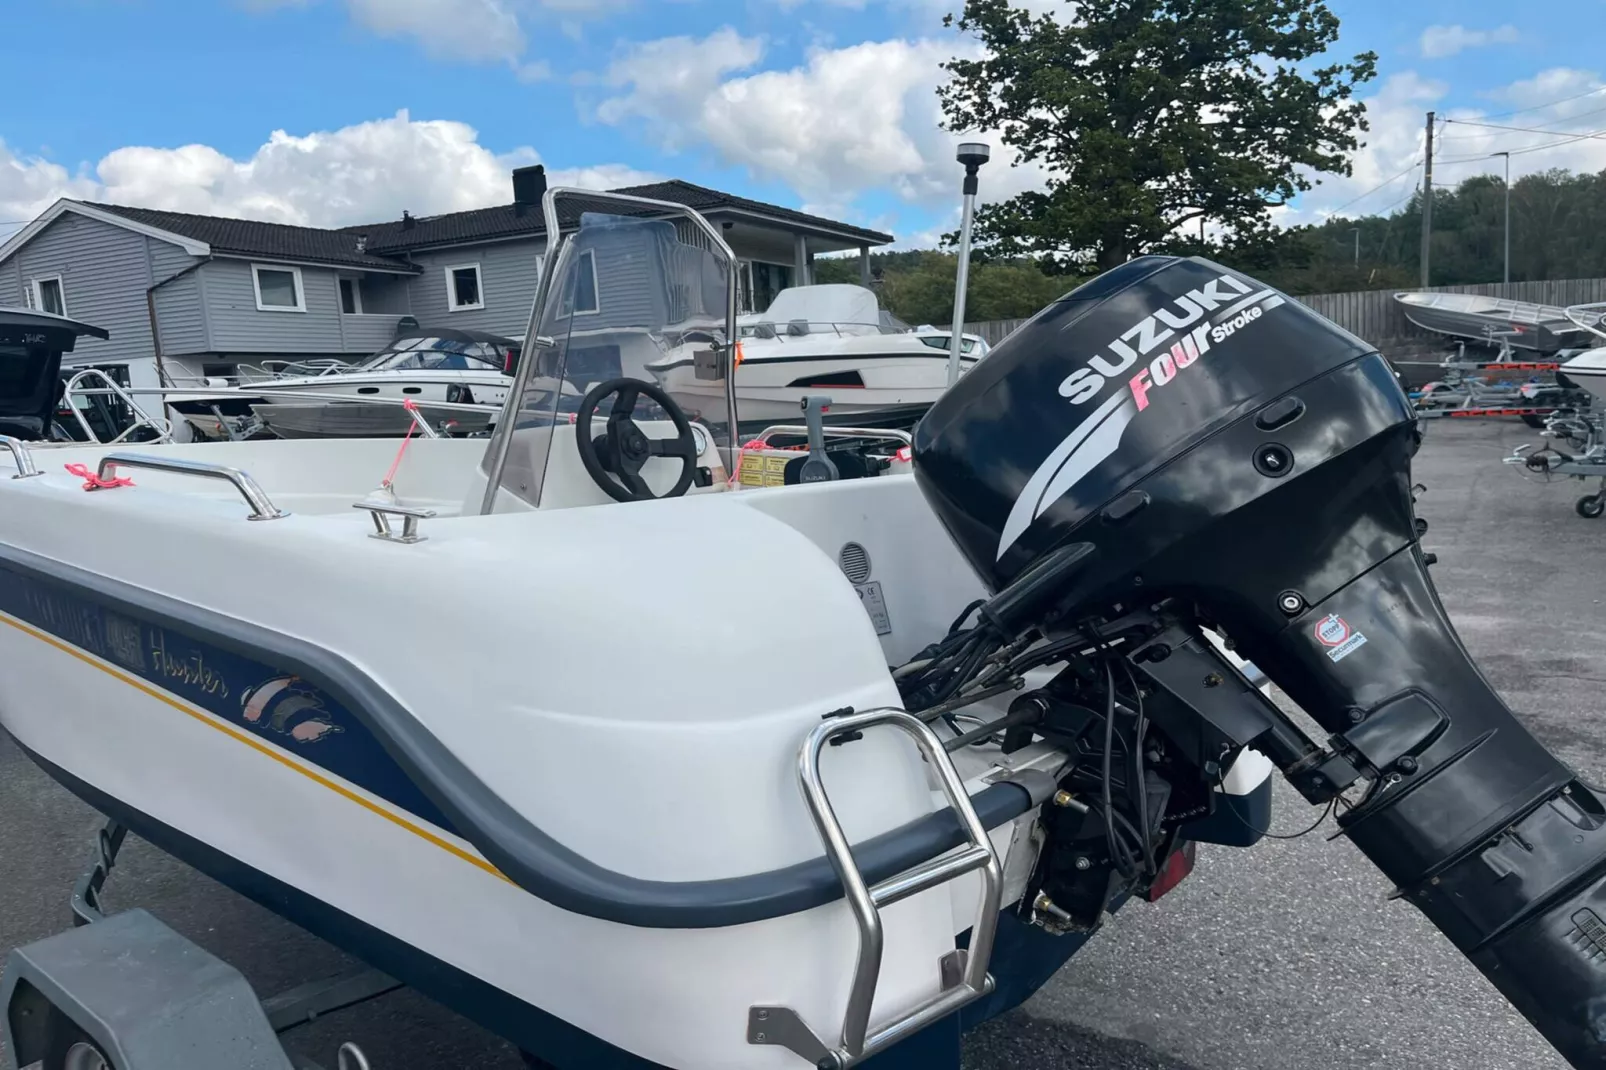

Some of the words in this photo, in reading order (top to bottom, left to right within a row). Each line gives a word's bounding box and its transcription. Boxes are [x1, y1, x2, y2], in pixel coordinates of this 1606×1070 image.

[1058, 275, 1253, 405] SUZUKI
[1211, 306, 1263, 344] Stroke
[1321, 623, 1340, 638] STOPP
